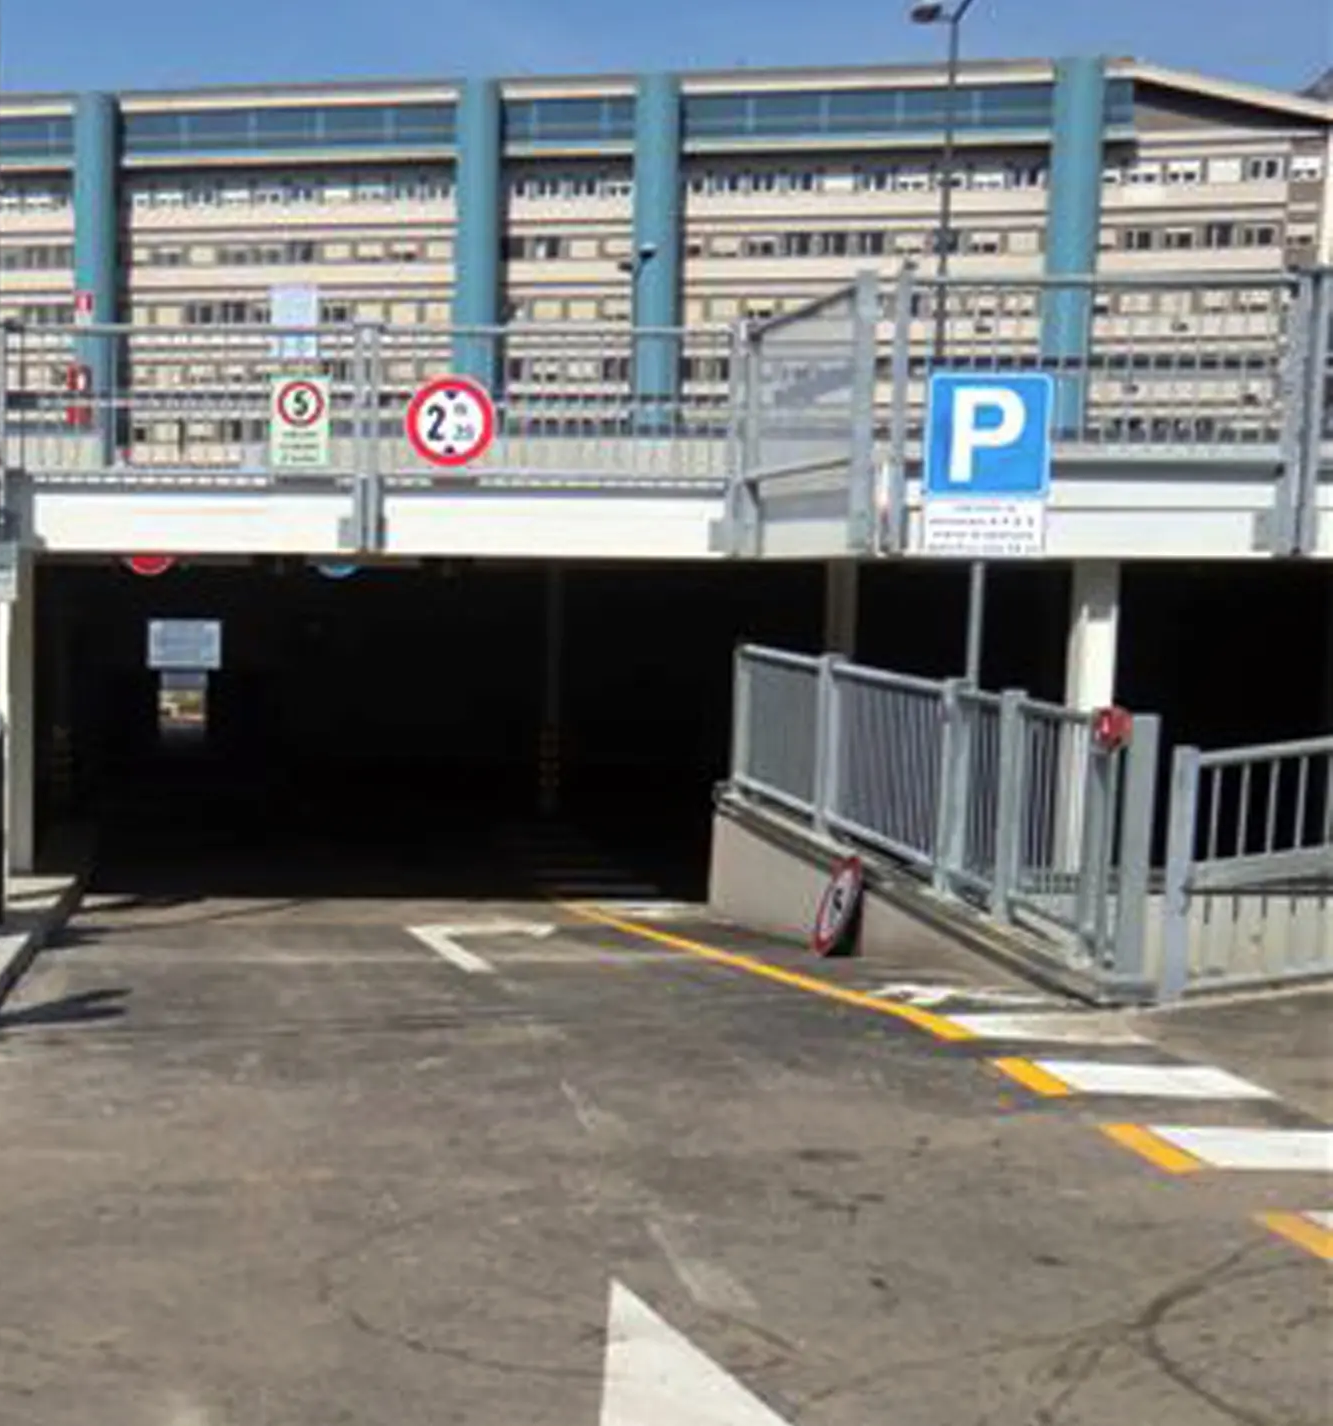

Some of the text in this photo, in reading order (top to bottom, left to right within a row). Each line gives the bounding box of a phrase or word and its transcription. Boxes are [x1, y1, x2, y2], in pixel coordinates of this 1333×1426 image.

[294, 389, 309, 417] 5
[427, 403, 446, 441] 2
[949, 386, 1027, 483] P
